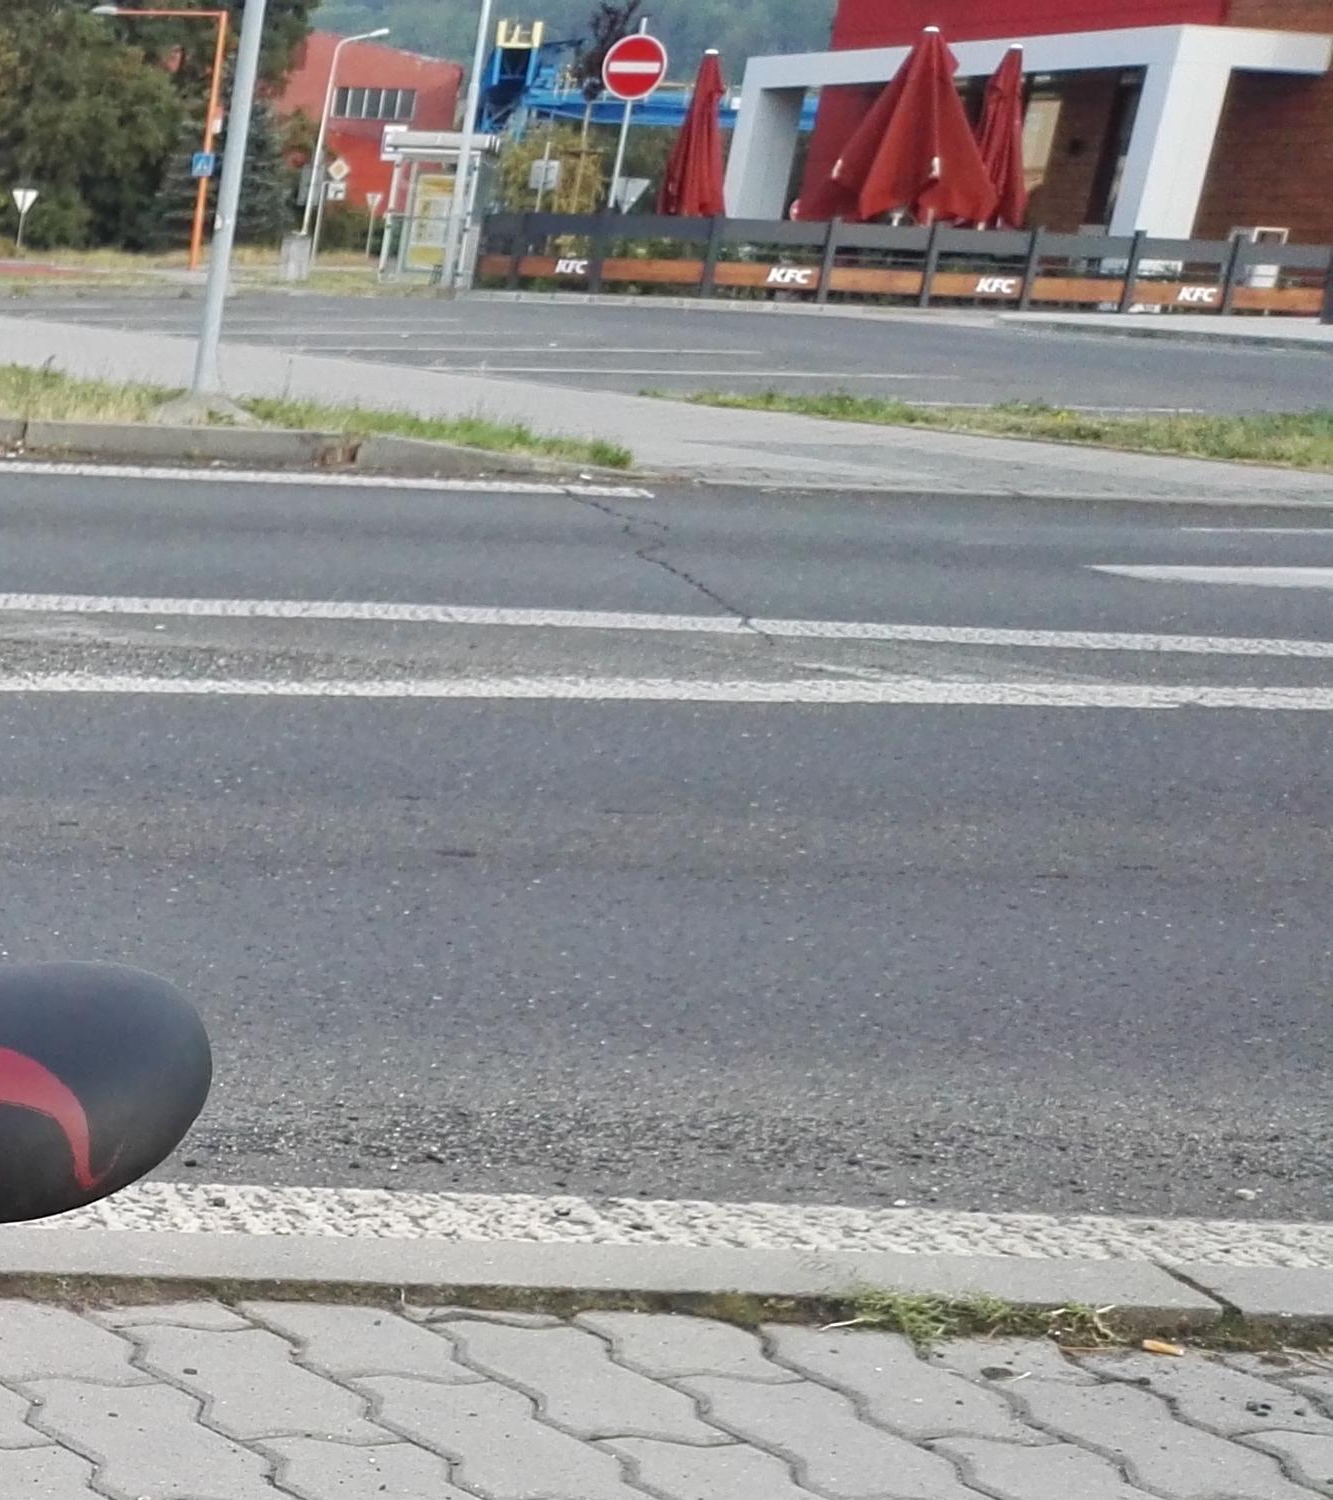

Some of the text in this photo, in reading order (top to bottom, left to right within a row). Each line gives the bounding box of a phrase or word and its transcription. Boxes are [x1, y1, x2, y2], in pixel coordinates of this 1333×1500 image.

[555, 259, 588, 274] KFC
[767, 267, 812, 284] KFC
[976, 278, 1015, 293] KFC
[1178, 286, 1217, 302] KFC
